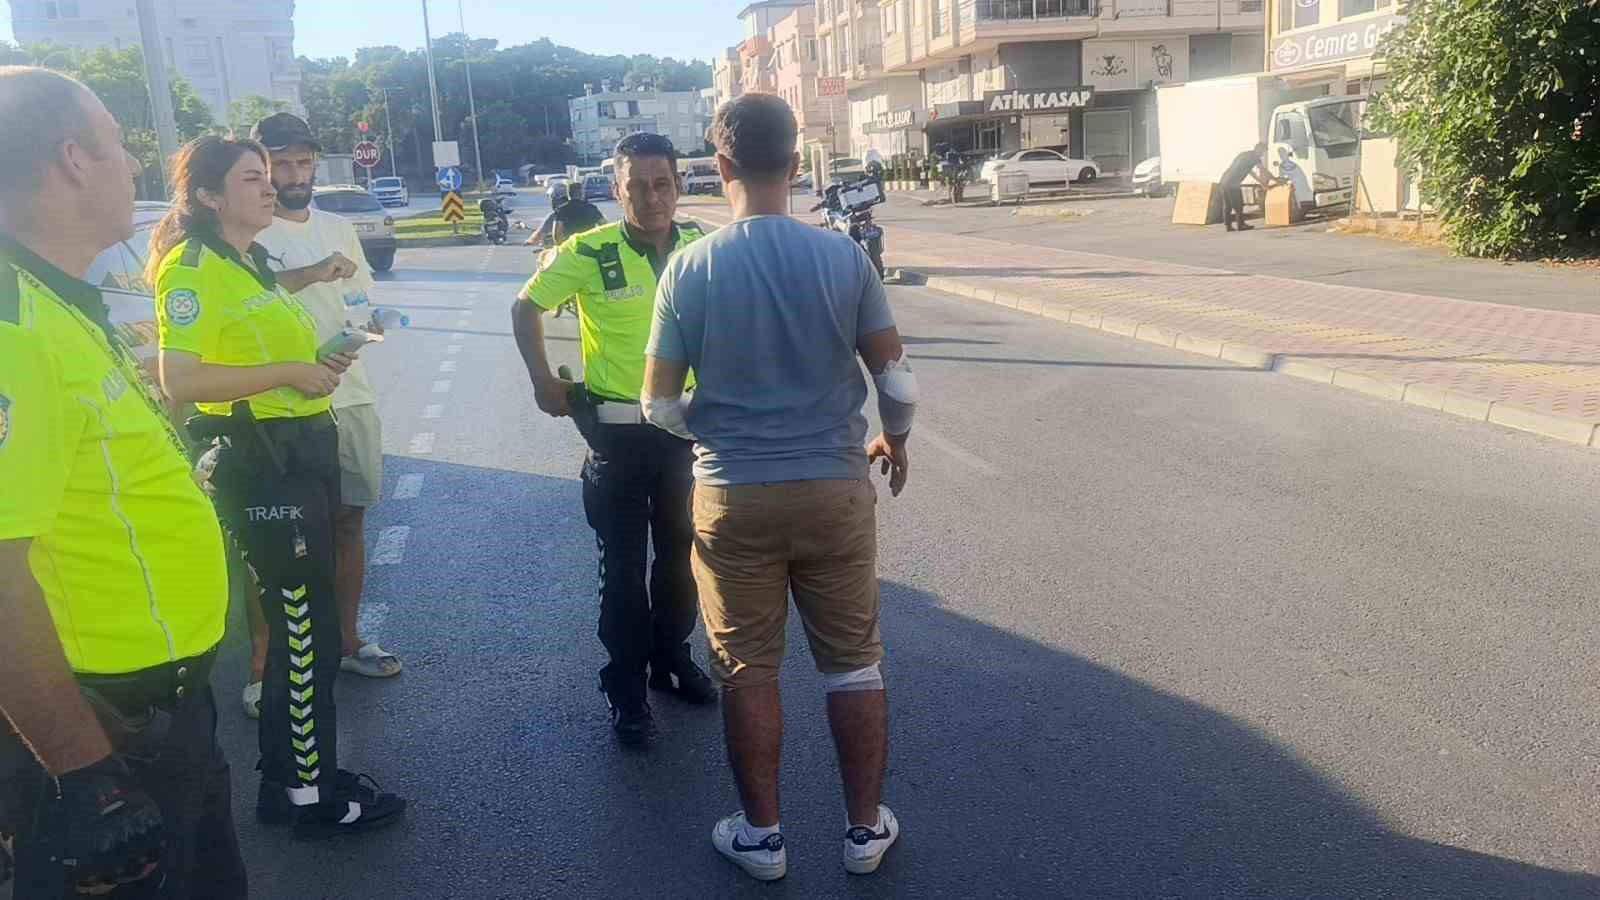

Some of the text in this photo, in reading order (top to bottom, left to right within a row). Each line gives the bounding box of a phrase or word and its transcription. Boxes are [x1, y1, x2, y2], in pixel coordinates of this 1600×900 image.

[1305, 31, 1358, 60] Cemre
[990, 90, 1091, 111] ATİK KASAP
[356, 149, 377, 160] DUR
